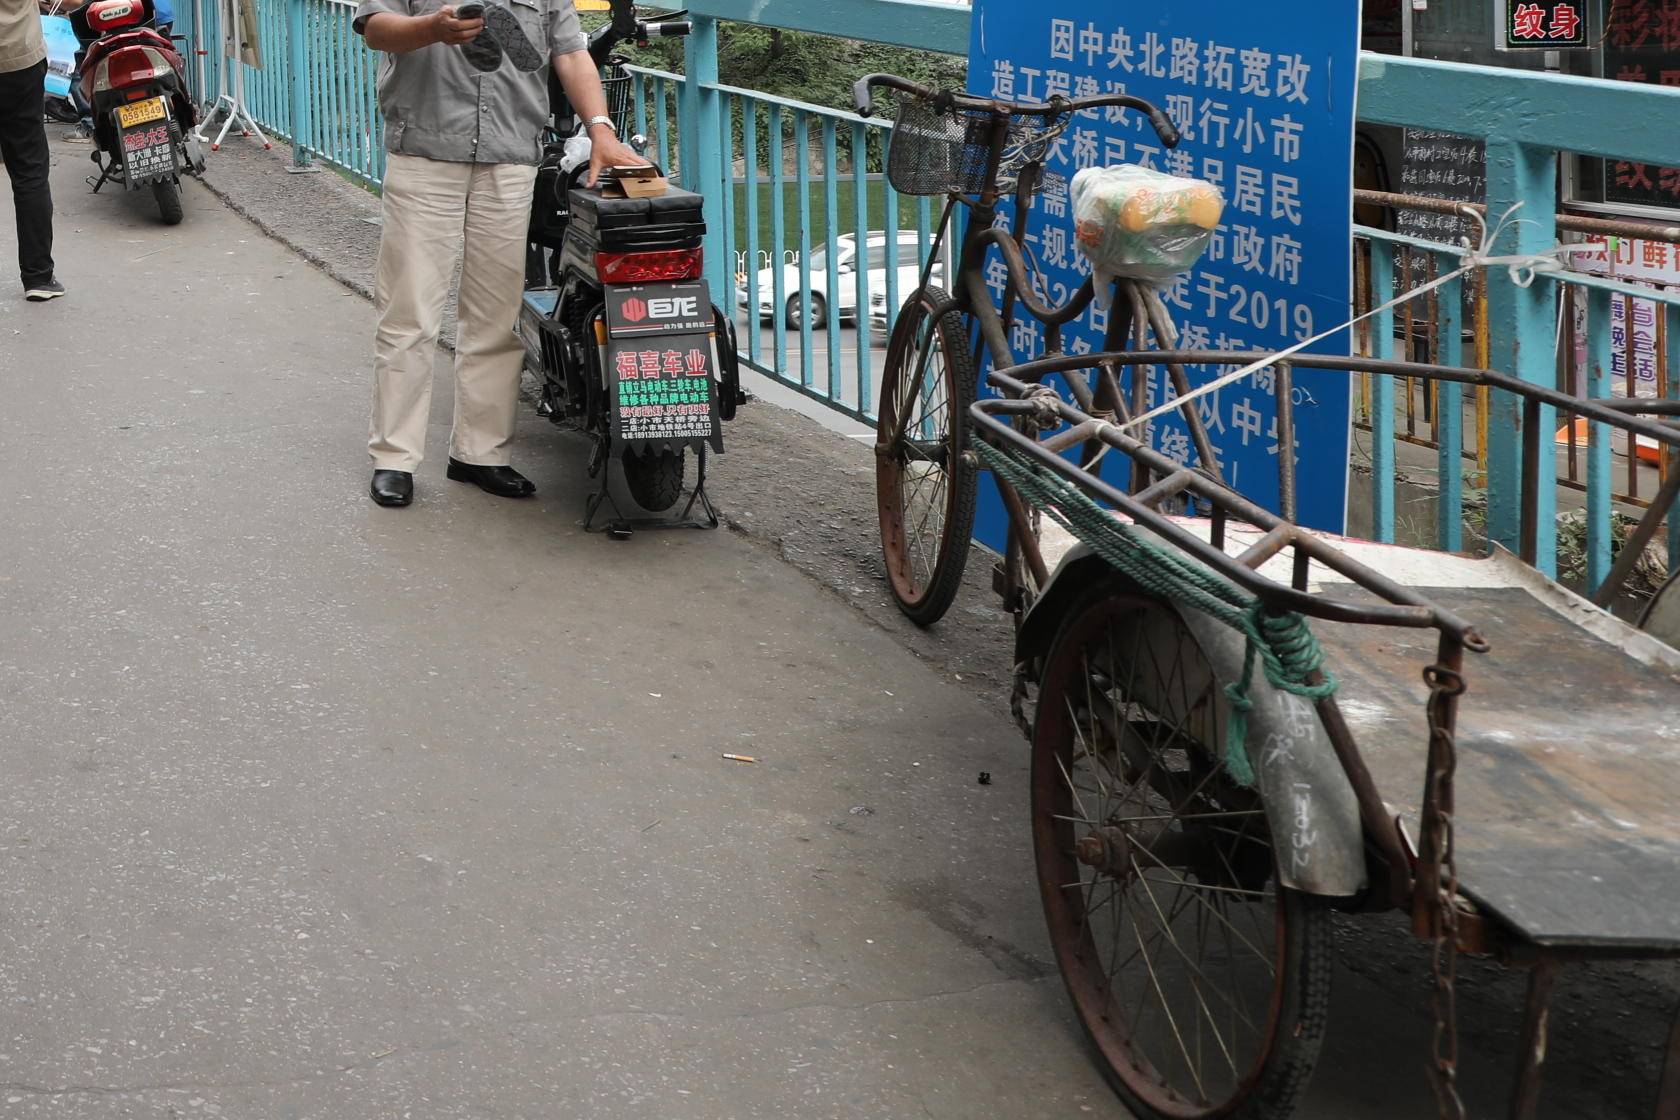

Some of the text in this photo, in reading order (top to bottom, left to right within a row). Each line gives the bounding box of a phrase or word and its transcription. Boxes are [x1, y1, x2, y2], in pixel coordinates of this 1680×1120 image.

[1513, 3, 1580, 39] 纹身
[1050, 18, 1311, 105] 因中央北路拓宽改
[122, 106, 162, 121] 0581549
[129, 153, 172, 169] 以旧换新
[1202, 222, 1302, 285] 市政府
[647, 296, 698, 318] 巨龙
[616, 349, 708, 380] 福喜车业
[619, 392, 709, 406] 维修各种品牌电动车
